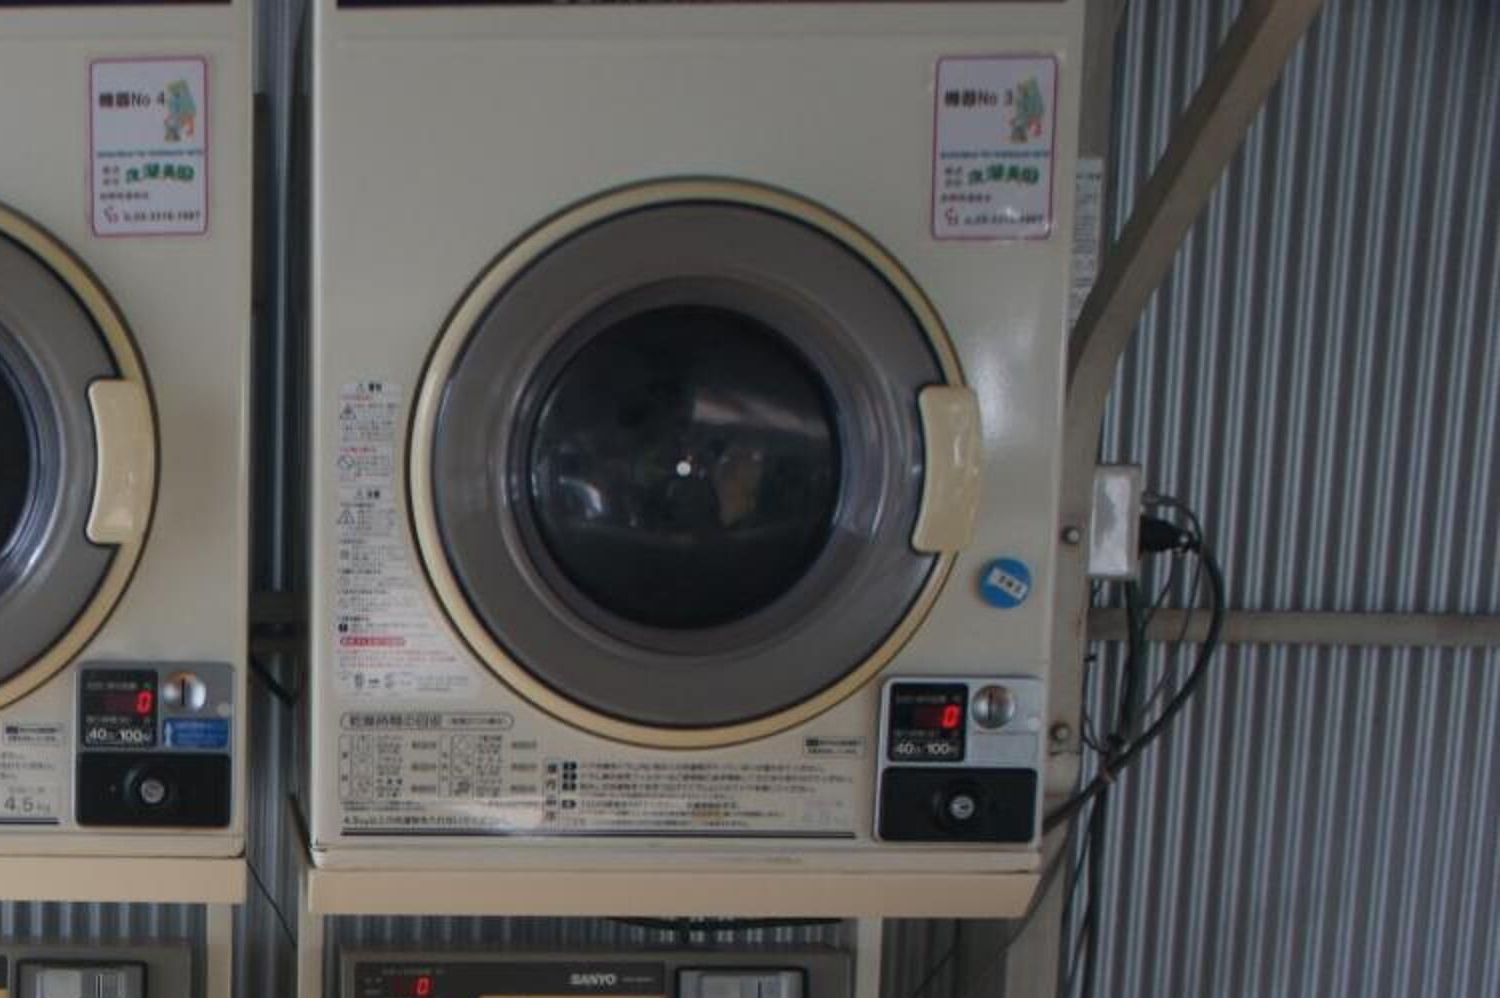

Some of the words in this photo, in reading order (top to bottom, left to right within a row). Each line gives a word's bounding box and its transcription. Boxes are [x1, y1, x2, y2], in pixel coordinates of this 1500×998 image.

[135, 690, 155, 716] 0
[942, 704, 962, 729] 0
[415, 976, 431, 997] 0
[568, 972, 617, 987] SANYO
